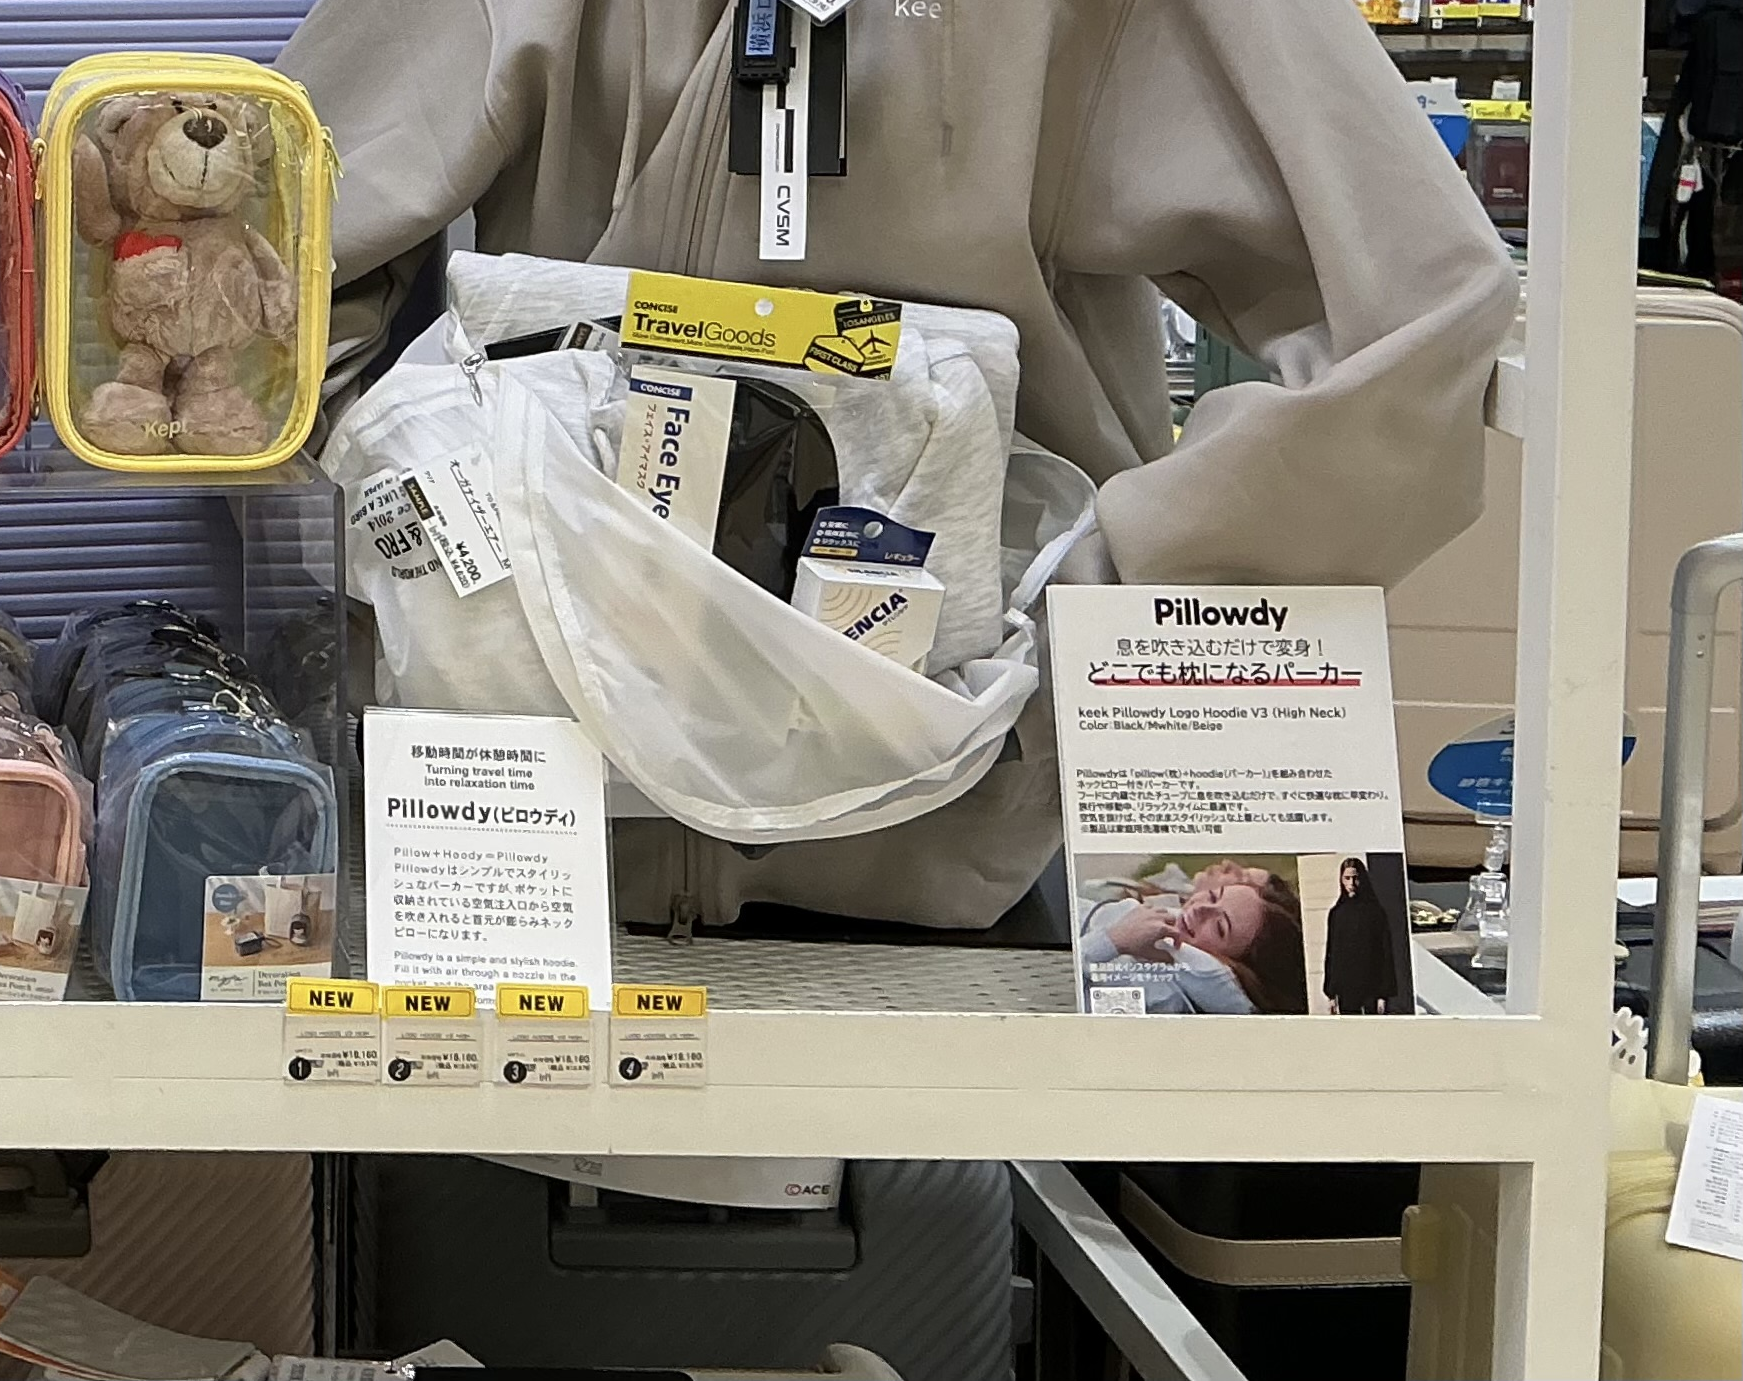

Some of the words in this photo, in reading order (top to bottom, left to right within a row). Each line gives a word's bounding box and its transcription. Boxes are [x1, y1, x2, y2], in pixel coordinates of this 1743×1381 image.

[776, 185, 791, 247] CVSM
[634, 300, 678, 314] CONCISE
[809, 346, 831, 361] FIRST
[831, 355, 858, 373] CLASS
[640, 382, 682, 397] CONCISE
[659, 406, 691, 467] Face
[378, 488, 399, 508] LIKE
[408, 482, 430, 516] SAMPLE
[649, 473, 681, 519] Eye
[369, 500, 375, 511] A
[367, 510, 394, 533] 2014
[374, 529, 412, 559] FRO
[842, 591, 908, 641] ENCIA
[1154, 598, 1288, 632] Pillowdy
[1116, 638, 1324, 657] 息を吹き込むだけで変身！
[1087, 661, 1363, 685] どこでも枕になるパーカー
[1078, 707, 1108, 718] keek
[1113, 707, 1166, 720] Pillowdy
[1169, 708, 1200, 720] Logo
[1203, 707, 1248, 718] Hoodie
[1250, 708, 1268, 718] V3
[1272, 707, 1306, 720] (High
[1310, 707, 1346, 719] Neck)
[411, 745, 546, 763] 移動時間が休憩時間に
[426, 764, 469, 778] Turning
[472, 766, 505, 777] travel
[508, 768, 533, 778] time
[424, 777, 446, 787] into
[449, 777, 506, 789] relaxation
[510, 780, 535, 791] time
[394, 927, 488, 942] ピローになります。
[394, 951, 433, 963] Pillowdy
[436, 952, 444, 962] is
[489, 955, 507, 964] and
[394, 965, 410, 974] Fill
[422, 966, 443, 975] with
[446, 967, 458, 976] air
[462, 968, 500, 980] through
[548, 971, 557, 980] in
[560, 972, 577, 981] the
[309, 989, 354, 1008] NEW
[405, 995, 450, 1011] NEW
[519, 994, 564, 1011] NEW
[637, 994, 683, 1011] NEW
[801, 1184, 831, 1196] ACE
